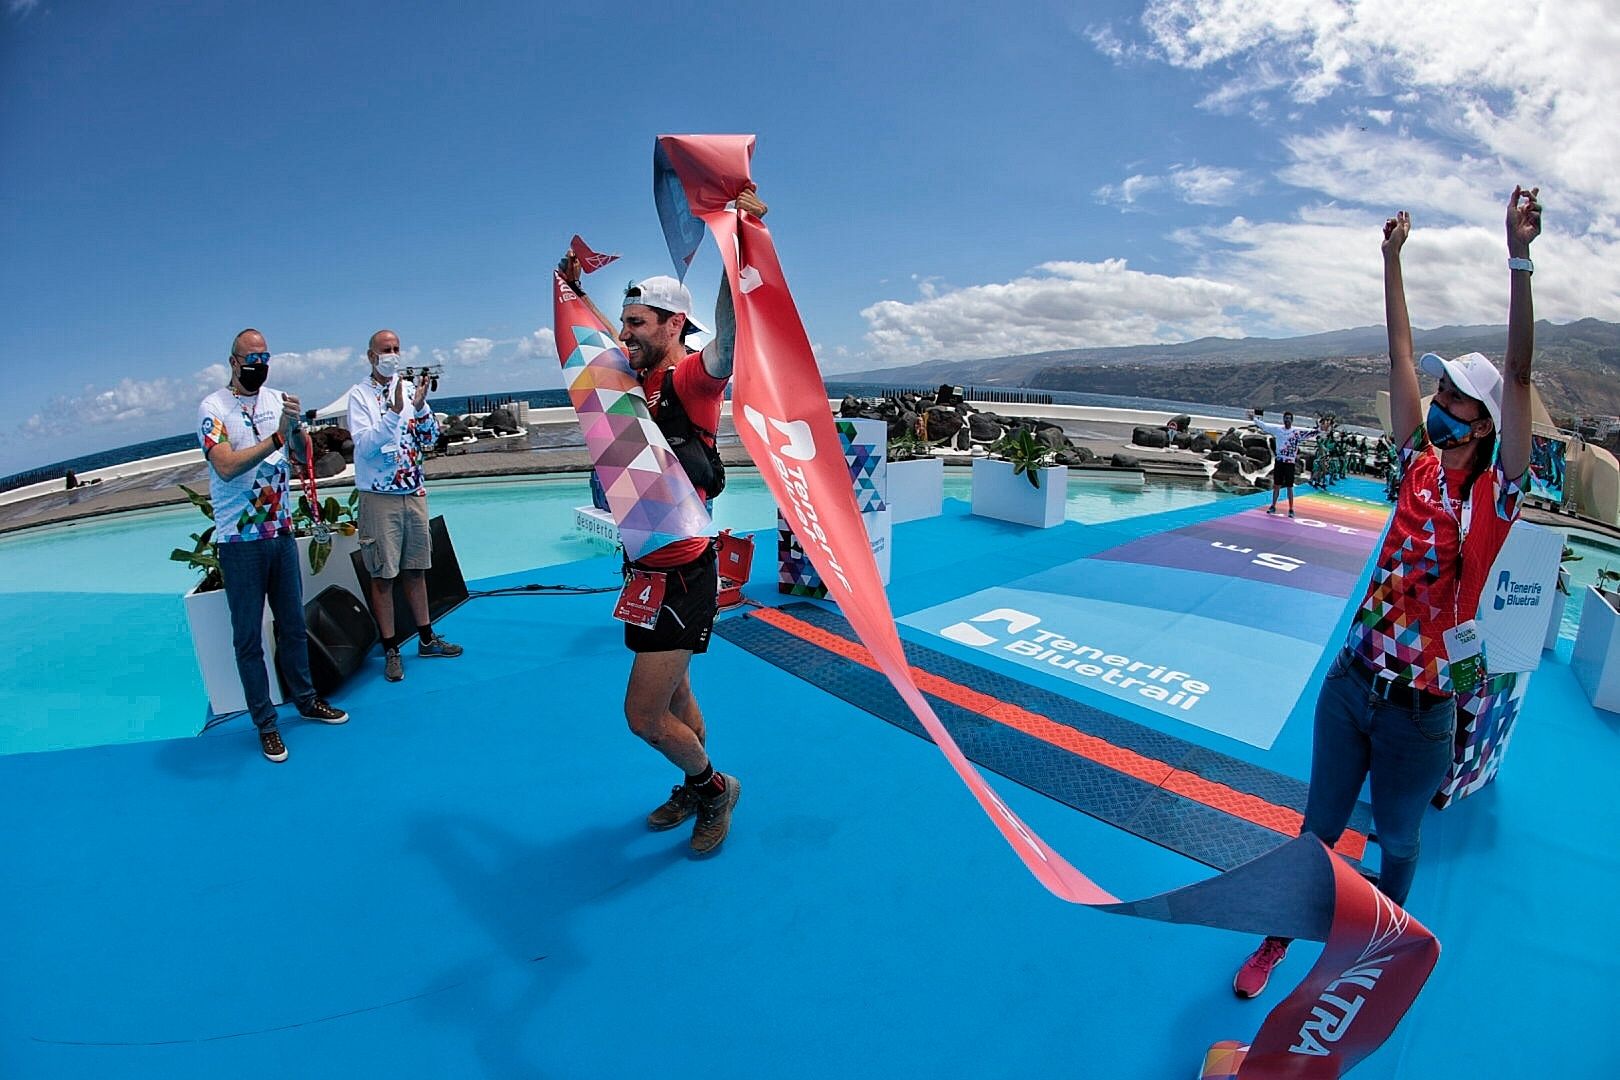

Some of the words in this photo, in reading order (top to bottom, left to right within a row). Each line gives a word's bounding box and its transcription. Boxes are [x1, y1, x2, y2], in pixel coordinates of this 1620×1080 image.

[638, 585, 652, 605] 4
[1506, 594, 1540, 606] Bluetrail
[1510, 581, 1542, 594] Tenerife
[1003, 639, 1199, 710] Bluetrail
[1034, 629, 1210, 695] Tenerife
[1288, 954, 1395, 1056] ULTRA
